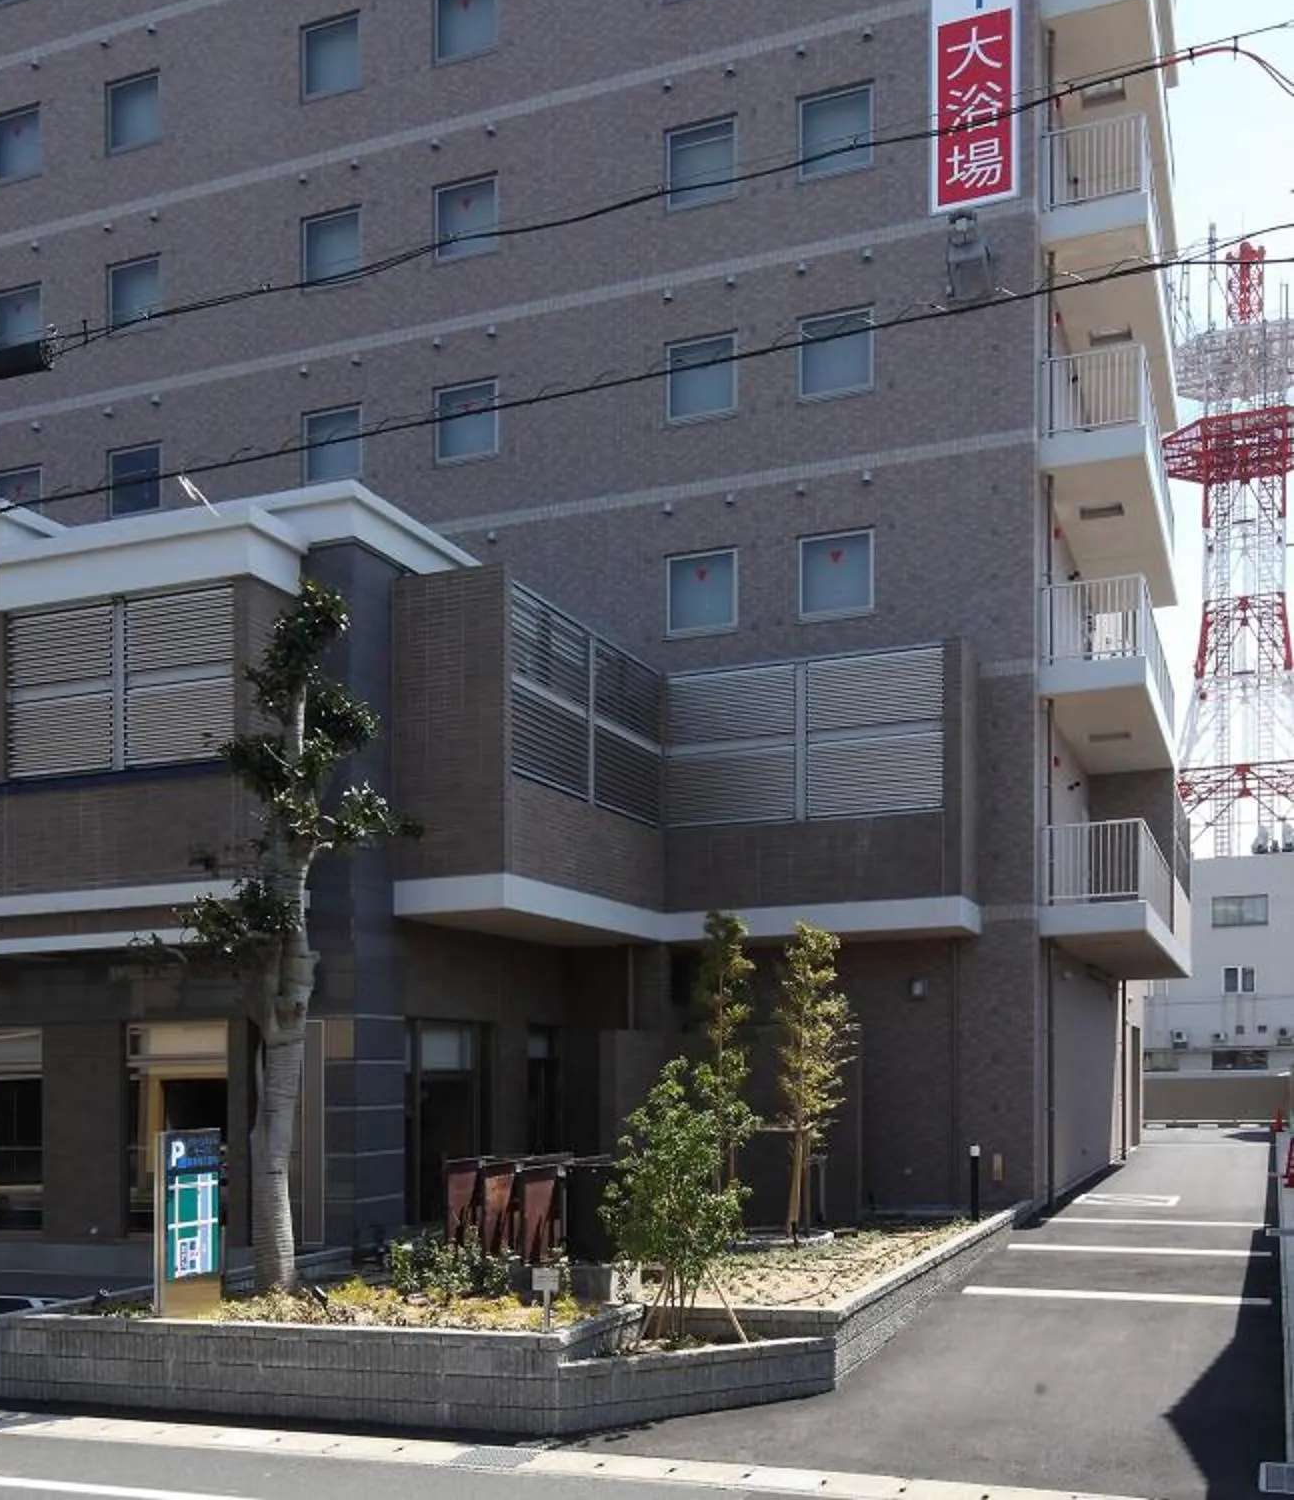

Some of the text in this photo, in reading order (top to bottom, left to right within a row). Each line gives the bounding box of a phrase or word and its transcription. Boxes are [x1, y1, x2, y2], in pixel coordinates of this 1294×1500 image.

[945, 25, 1004, 190] 大浴場
[171, 1140, 185, 1167] P
